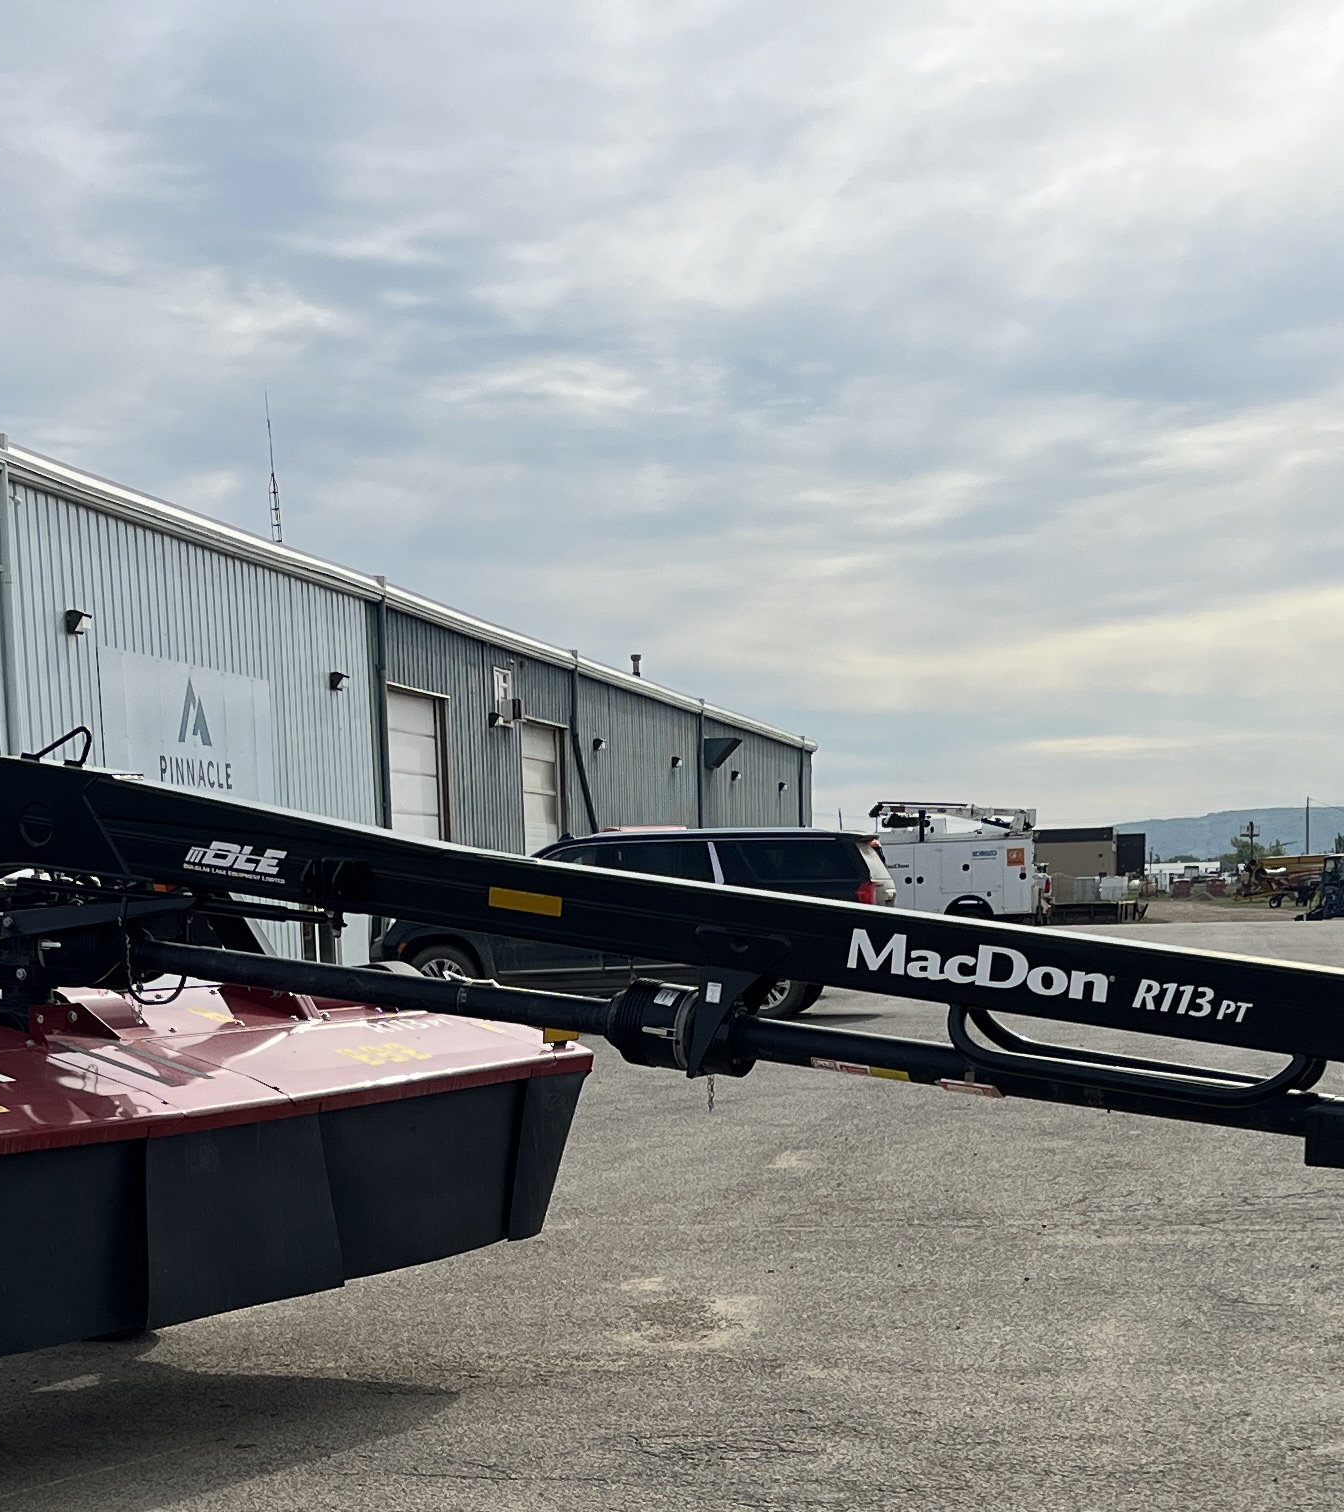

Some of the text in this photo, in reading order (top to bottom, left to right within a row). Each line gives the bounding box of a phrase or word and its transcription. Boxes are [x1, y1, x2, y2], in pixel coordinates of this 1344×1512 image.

[159, 755, 233, 790] PINNACLE
[846, 928, 1254, 1023] MacDon R113 PT
